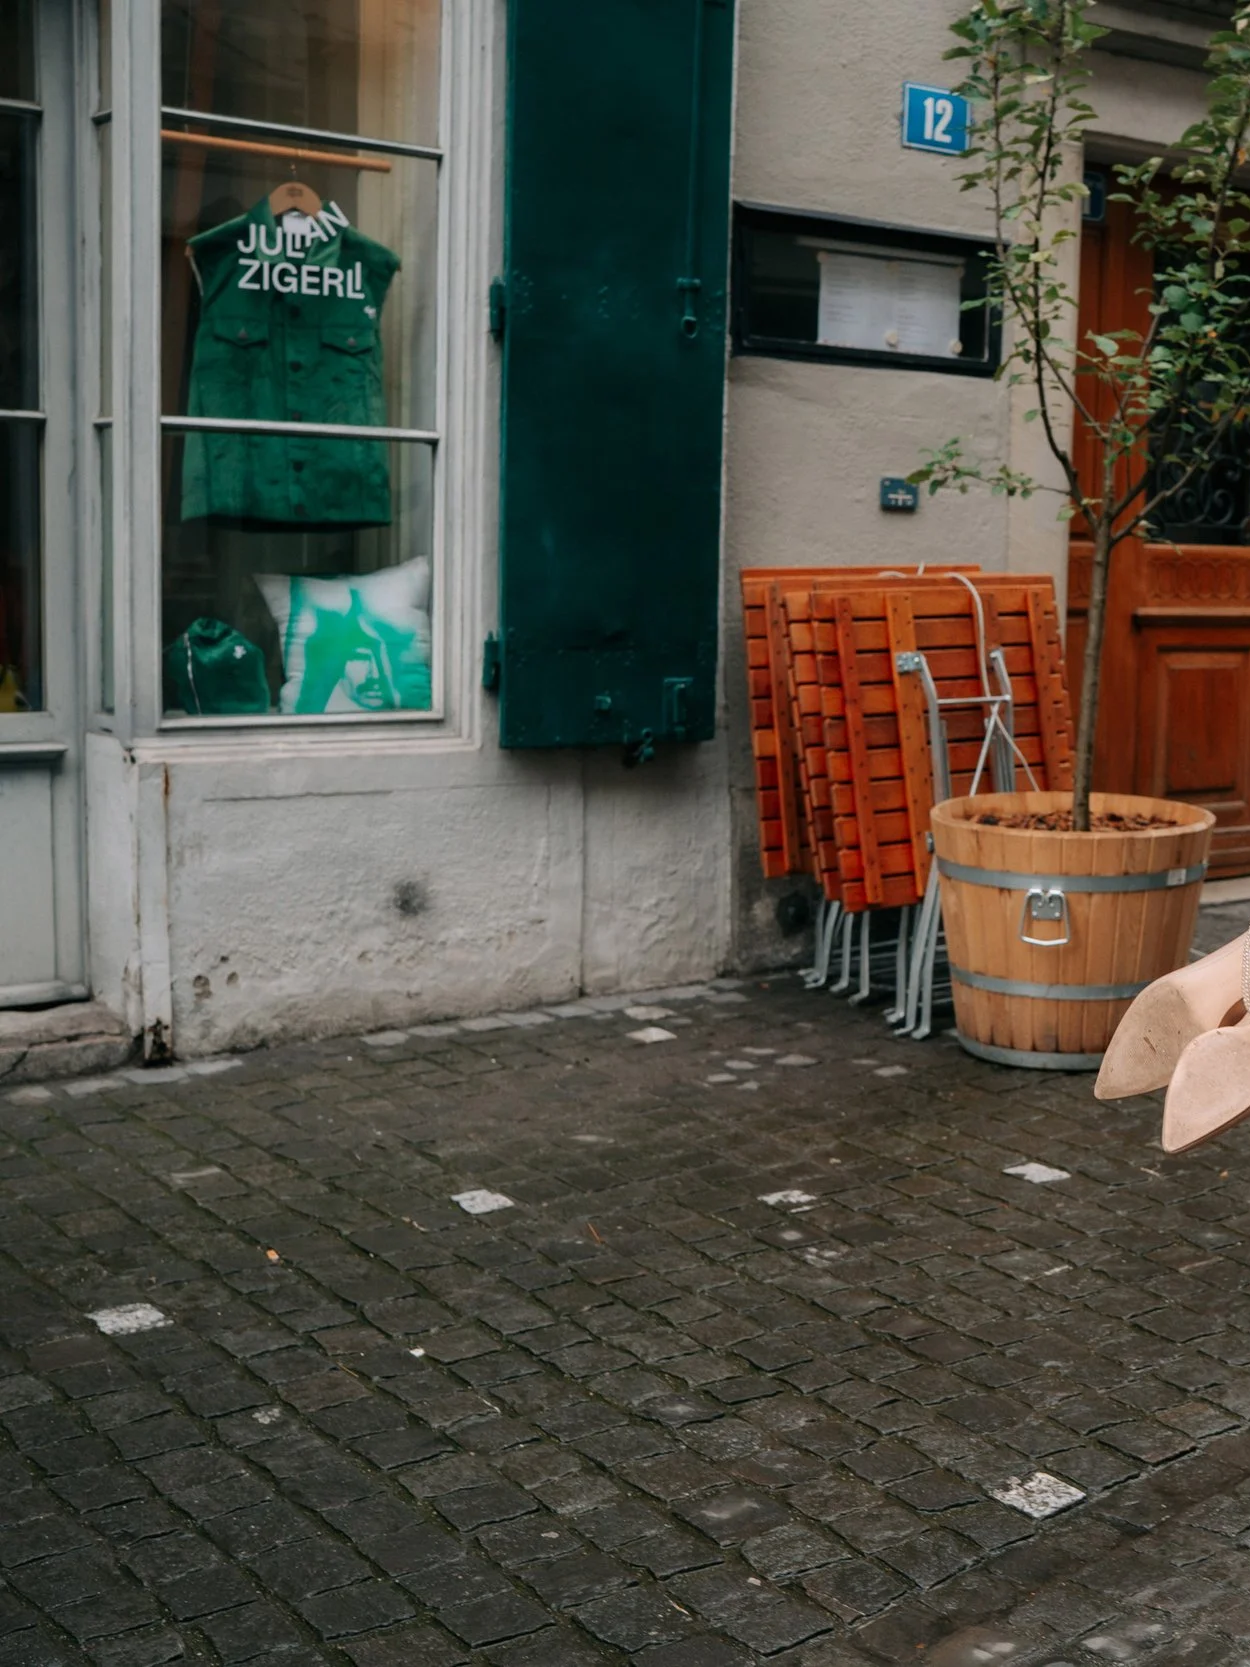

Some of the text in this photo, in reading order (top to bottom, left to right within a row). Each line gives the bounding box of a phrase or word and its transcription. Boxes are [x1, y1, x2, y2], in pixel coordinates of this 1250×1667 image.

[923, 96, 953, 144] 12
[237, 201, 349, 258] JULIAN
[238, 258, 365, 299] ZIGERLI
